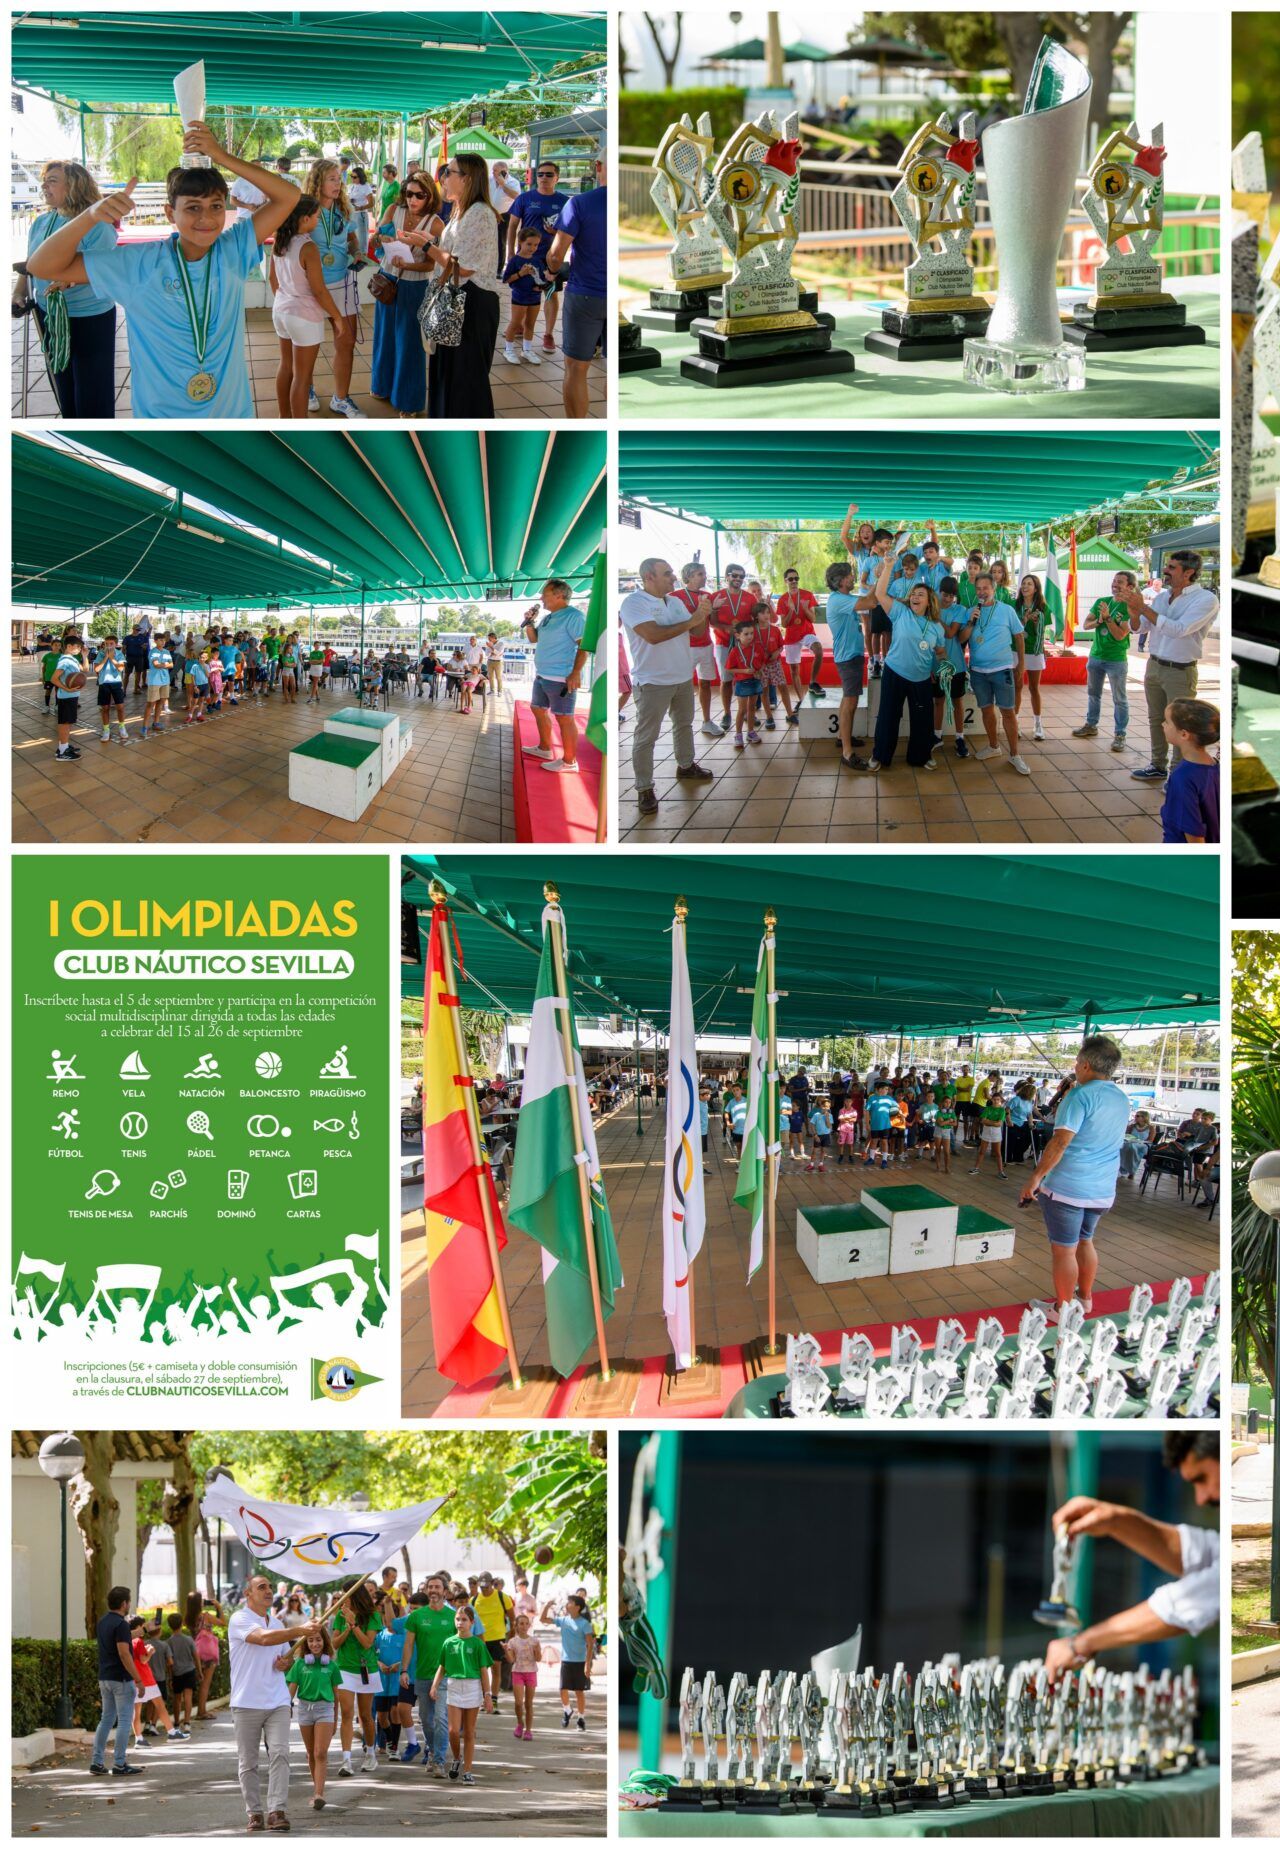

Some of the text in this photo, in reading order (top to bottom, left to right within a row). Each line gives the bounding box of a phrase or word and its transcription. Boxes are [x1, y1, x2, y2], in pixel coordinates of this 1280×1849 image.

[758, 282, 794, 290] CLASIFICADO
[964, 708, 974, 724] 2
[828, 714, 840, 734] 3
[368, 772, 372, 788] 2
[50, 899, 358, 938] I OLIMPIADAS
[64, 950, 350, 974] CLUB NÁUTICO SEVILLA
[24, 993, 376, 1010] Inscríbete hasta el 5 de septiembre y participa en la competición
[64, 1008, 336, 1025] social multidisciplinar dirigida a todas las edades
[100, 1024, 302, 1040] a celebrar del 15 al 26 de septiembre
[52, 1090, 80, 1098] REMO
[122, 1090, 146, 1098] VELA
[179, 1087, 224, 1098] NATACIÓN
[240, 1090, 300, 1098] BALONCESTO
[310, 1088, 366, 1098] PIRAGÜISMO
[48, 1148, 84, 1158] FÚTBOL
[188, 1148, 216, 1158] PÁDEL
[68, 1210, 133, 1218] TENIS DE MESA
[150, 1208, 188, 1218] PARCHÍS
[218, 1208, 256, 1218] DOMINÓ
[286, 1210, 320, 1218] CARTAS
[920, 1228, 928, 1241] 1
[980, 1241, 989, 1254] 3
[849, 1249, 860, 1263] 2
[64, 1361, 126, 1372] Inscripciones
[129, 1360, 145, 1372] (5€
[155, 1362, 198, 1370] camiseta
[200, 1364, 205, 1372] y
[208, 1360, 235, 1370] doble
[238, 1361, 298, 1370] consumisión
[91, 1374, 98, 1383] la
[101, 1374, 144, 1384] clausura,
[145, 1374, 154, 1383] el
[156, 1374, 191, 1383] sábado
[194, 1376, 205, 1384] 27
[208, 1374, 220, 1383] de
[222, 1374, 282, 1385] septiembre),
[81, 1386, 110, 1396] través
[112, 1386, 124, 1396] de
[126, 1386, 288, 1396] CLUBNAUTICOSEVILLA.COM
